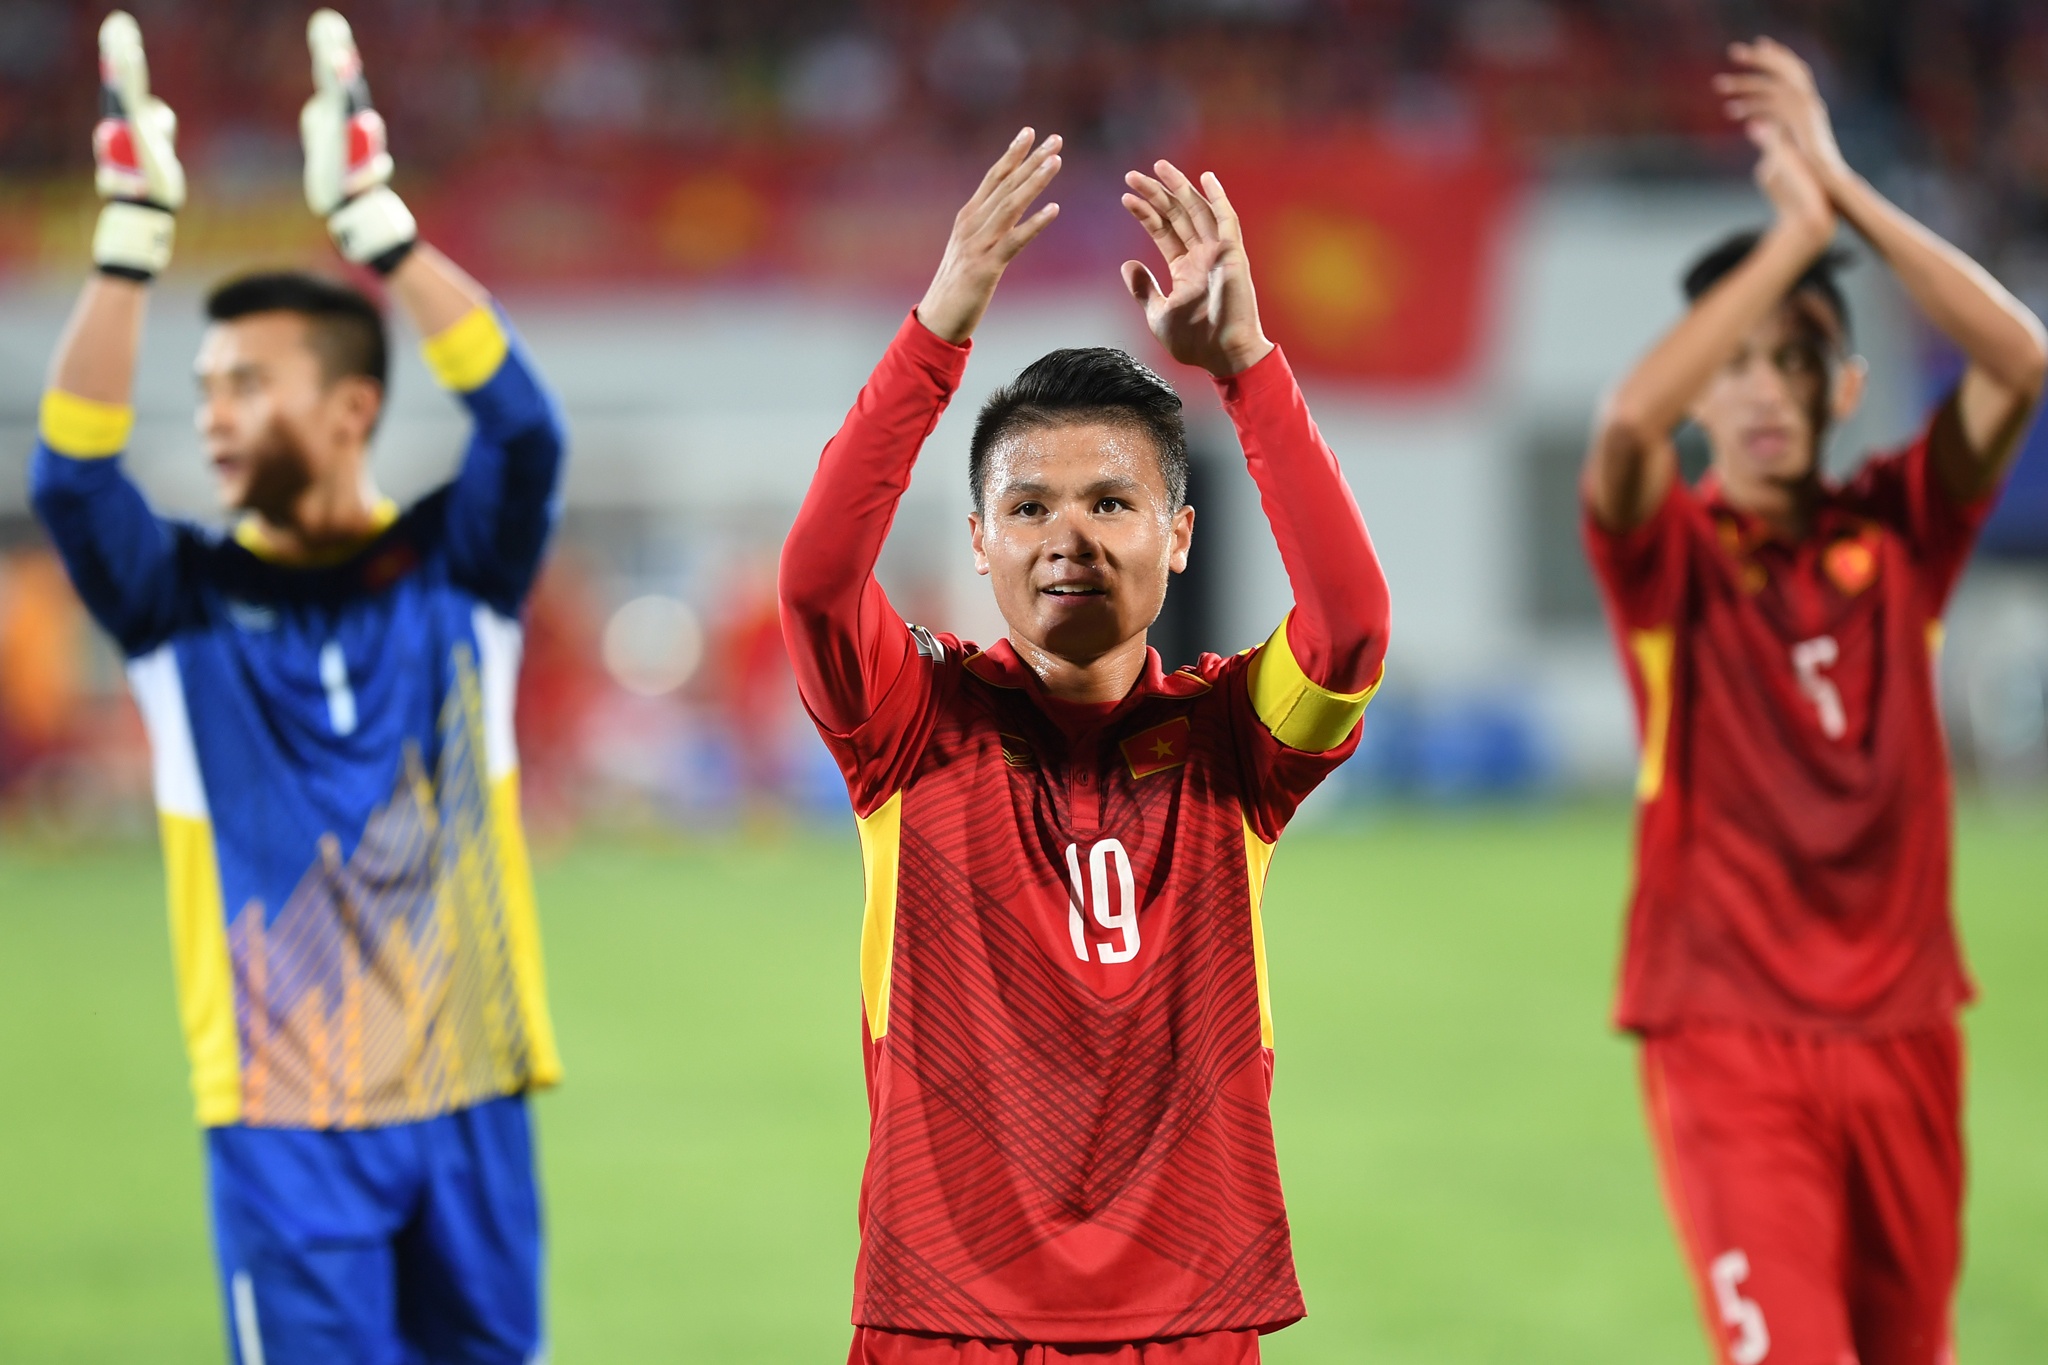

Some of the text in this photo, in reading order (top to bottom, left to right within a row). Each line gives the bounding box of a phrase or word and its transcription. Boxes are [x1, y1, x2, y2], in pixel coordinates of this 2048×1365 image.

[319, 640, 357, 737] 1
[1792, 635, 1846, 739] 5
[1066, 839, 1141, 964] 19
[1711, 1249, 1770, 1365] 5
